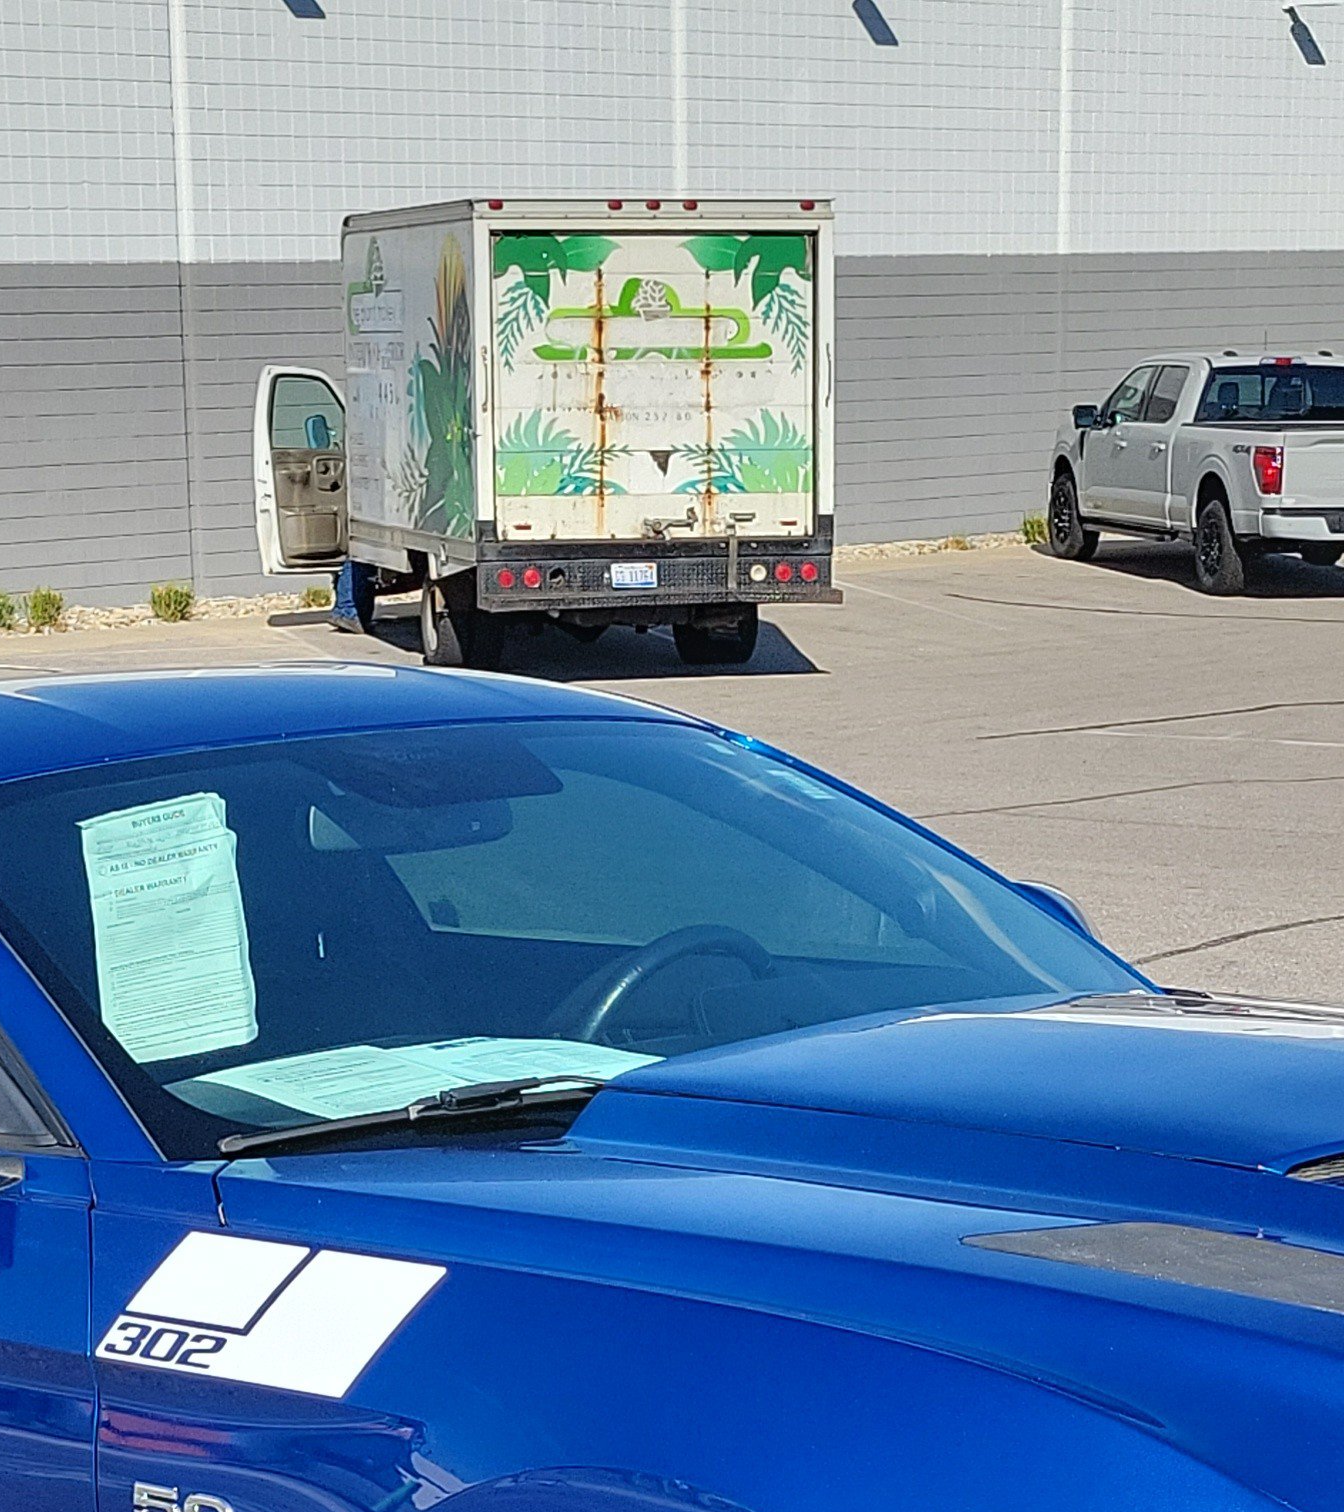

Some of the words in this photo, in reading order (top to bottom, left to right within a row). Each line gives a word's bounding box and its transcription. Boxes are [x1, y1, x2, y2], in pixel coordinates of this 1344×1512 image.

[131, 815, 161, 829] BUYERS
[148, 853, 177, 866] DEALER
[114, 884, 144, 898] DEALER
[146, 875, 188, 891] WARRANTY
[104, 1321, 227, 1370] 302
